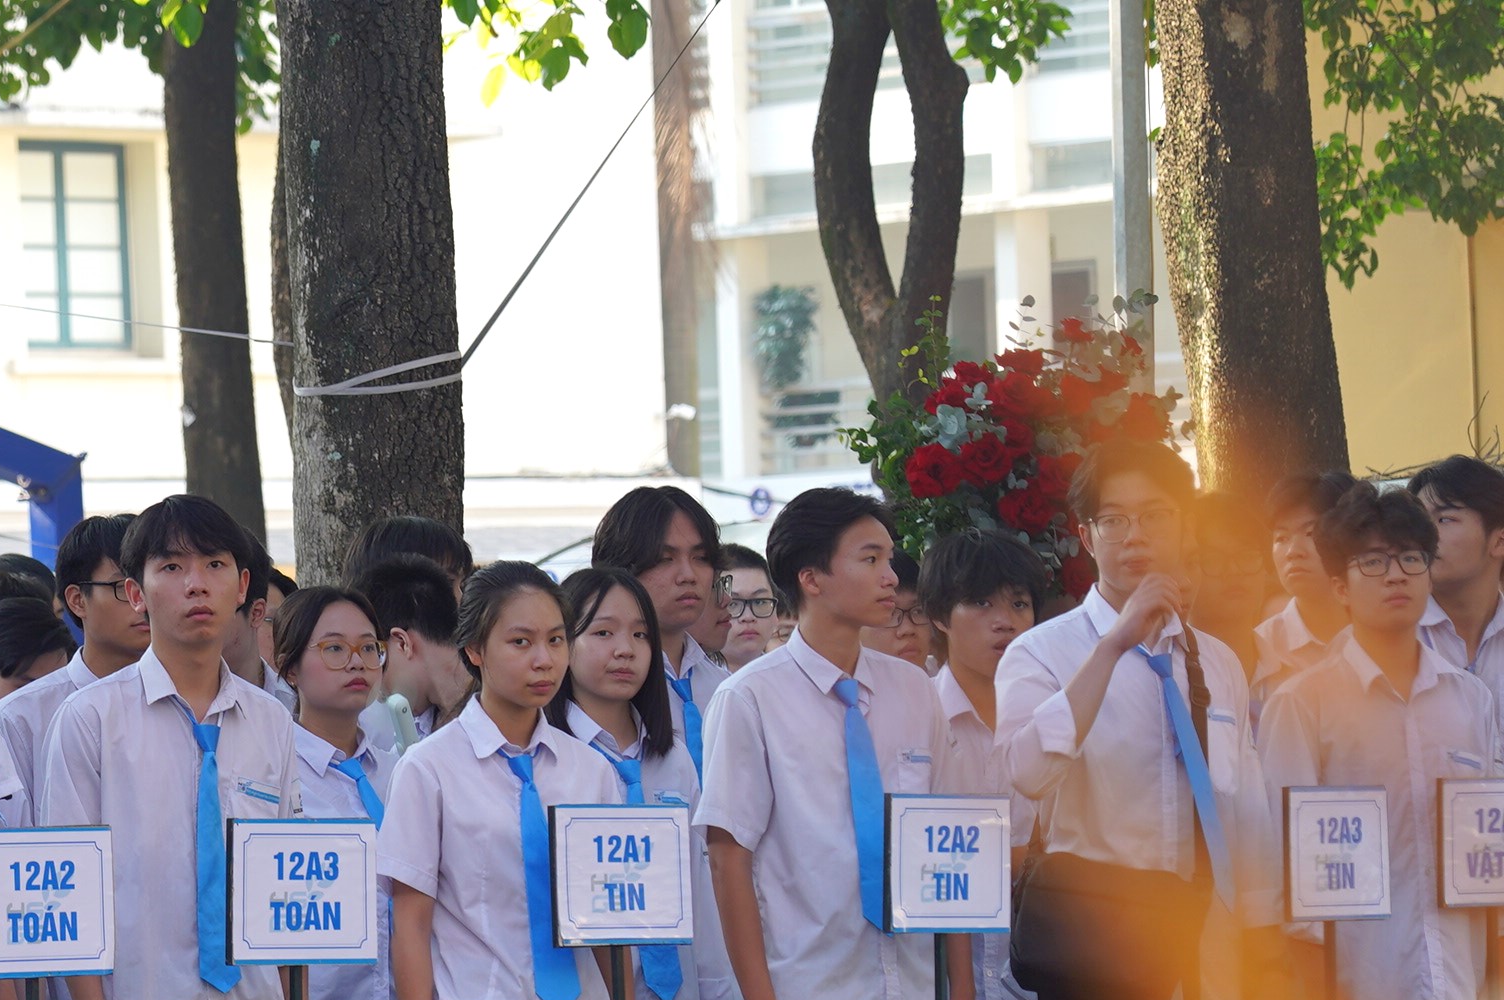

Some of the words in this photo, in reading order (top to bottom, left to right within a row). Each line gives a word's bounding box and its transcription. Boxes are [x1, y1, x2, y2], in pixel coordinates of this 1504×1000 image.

[1317, 817, 1362, 844] 12A3
[1475, 807, 1504, 833] 12
[593, 835, 651, 863] 12A1
[925, 825, 980, 853] 12A2
[10, 860, 75, 891] 12A2
[273, 851, 339, 881] 12A3
[1325, 862, 1355, 890] TIN
[604, 883, 645, 911] TIN
[933, 873, 969, 901] TIN
[7, 905, 78, 943] TOÁN
[269, 895, 341, 931] TOÁN
